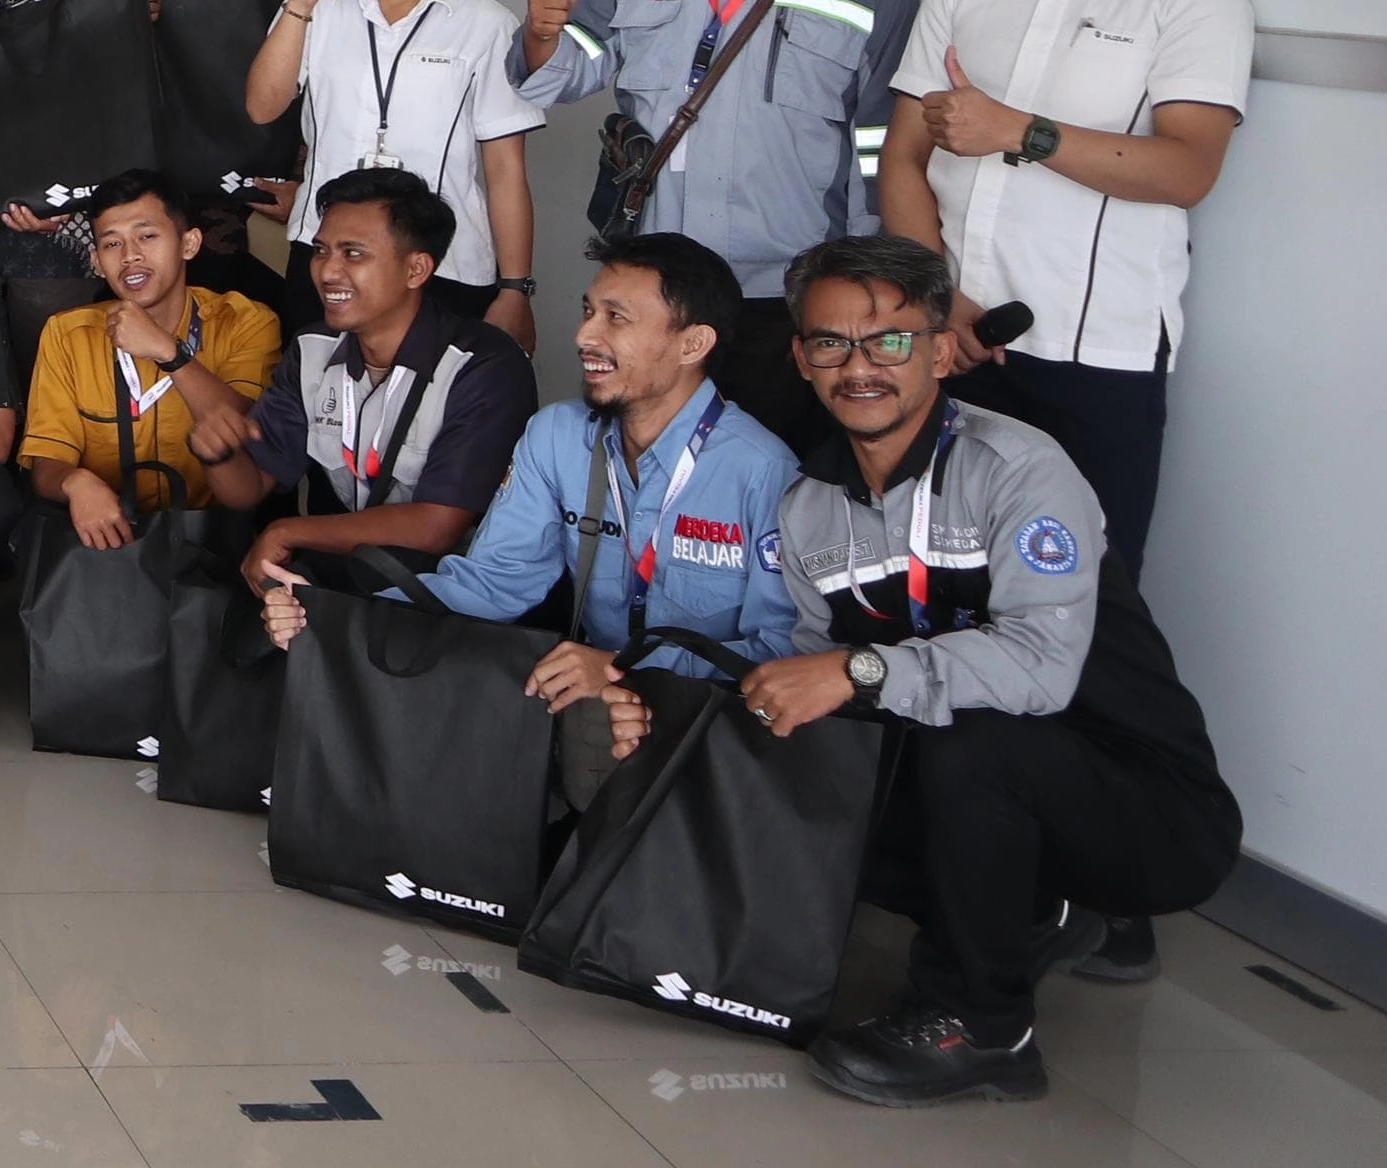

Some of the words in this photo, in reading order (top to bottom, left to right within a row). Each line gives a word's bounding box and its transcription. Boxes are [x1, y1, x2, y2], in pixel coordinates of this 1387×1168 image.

[674, 513, 744, 546] MERDEKA
[672, 536, 744, 569] BELAJAR
[420, 887, 505, 918] SUZUKI
[692, 991, 791, 1029] SUZUKI
